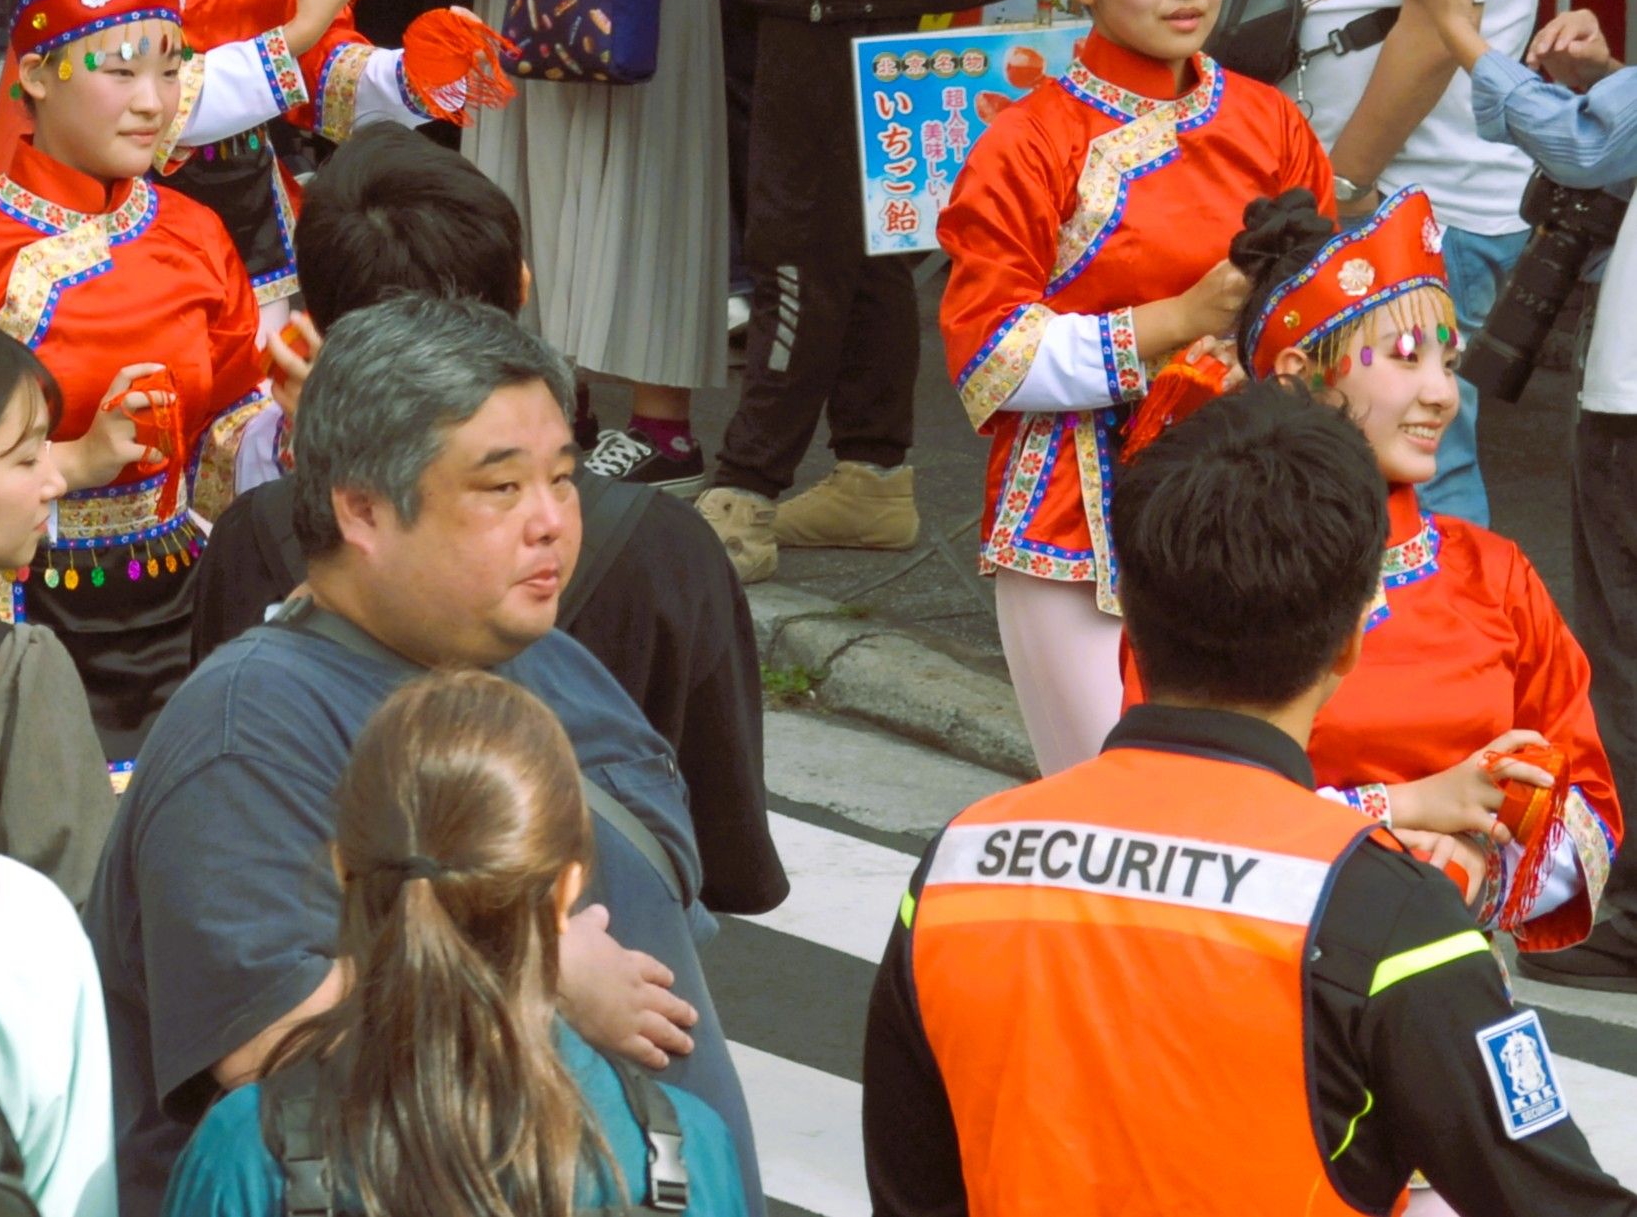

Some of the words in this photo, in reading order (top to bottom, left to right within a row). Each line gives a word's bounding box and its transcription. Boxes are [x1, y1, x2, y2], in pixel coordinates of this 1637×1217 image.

[875, 50, 986, 77] 北京名物
[875, 90, 918, 233] いちご飴
[976, 829, 1260, 904] SECURITY
